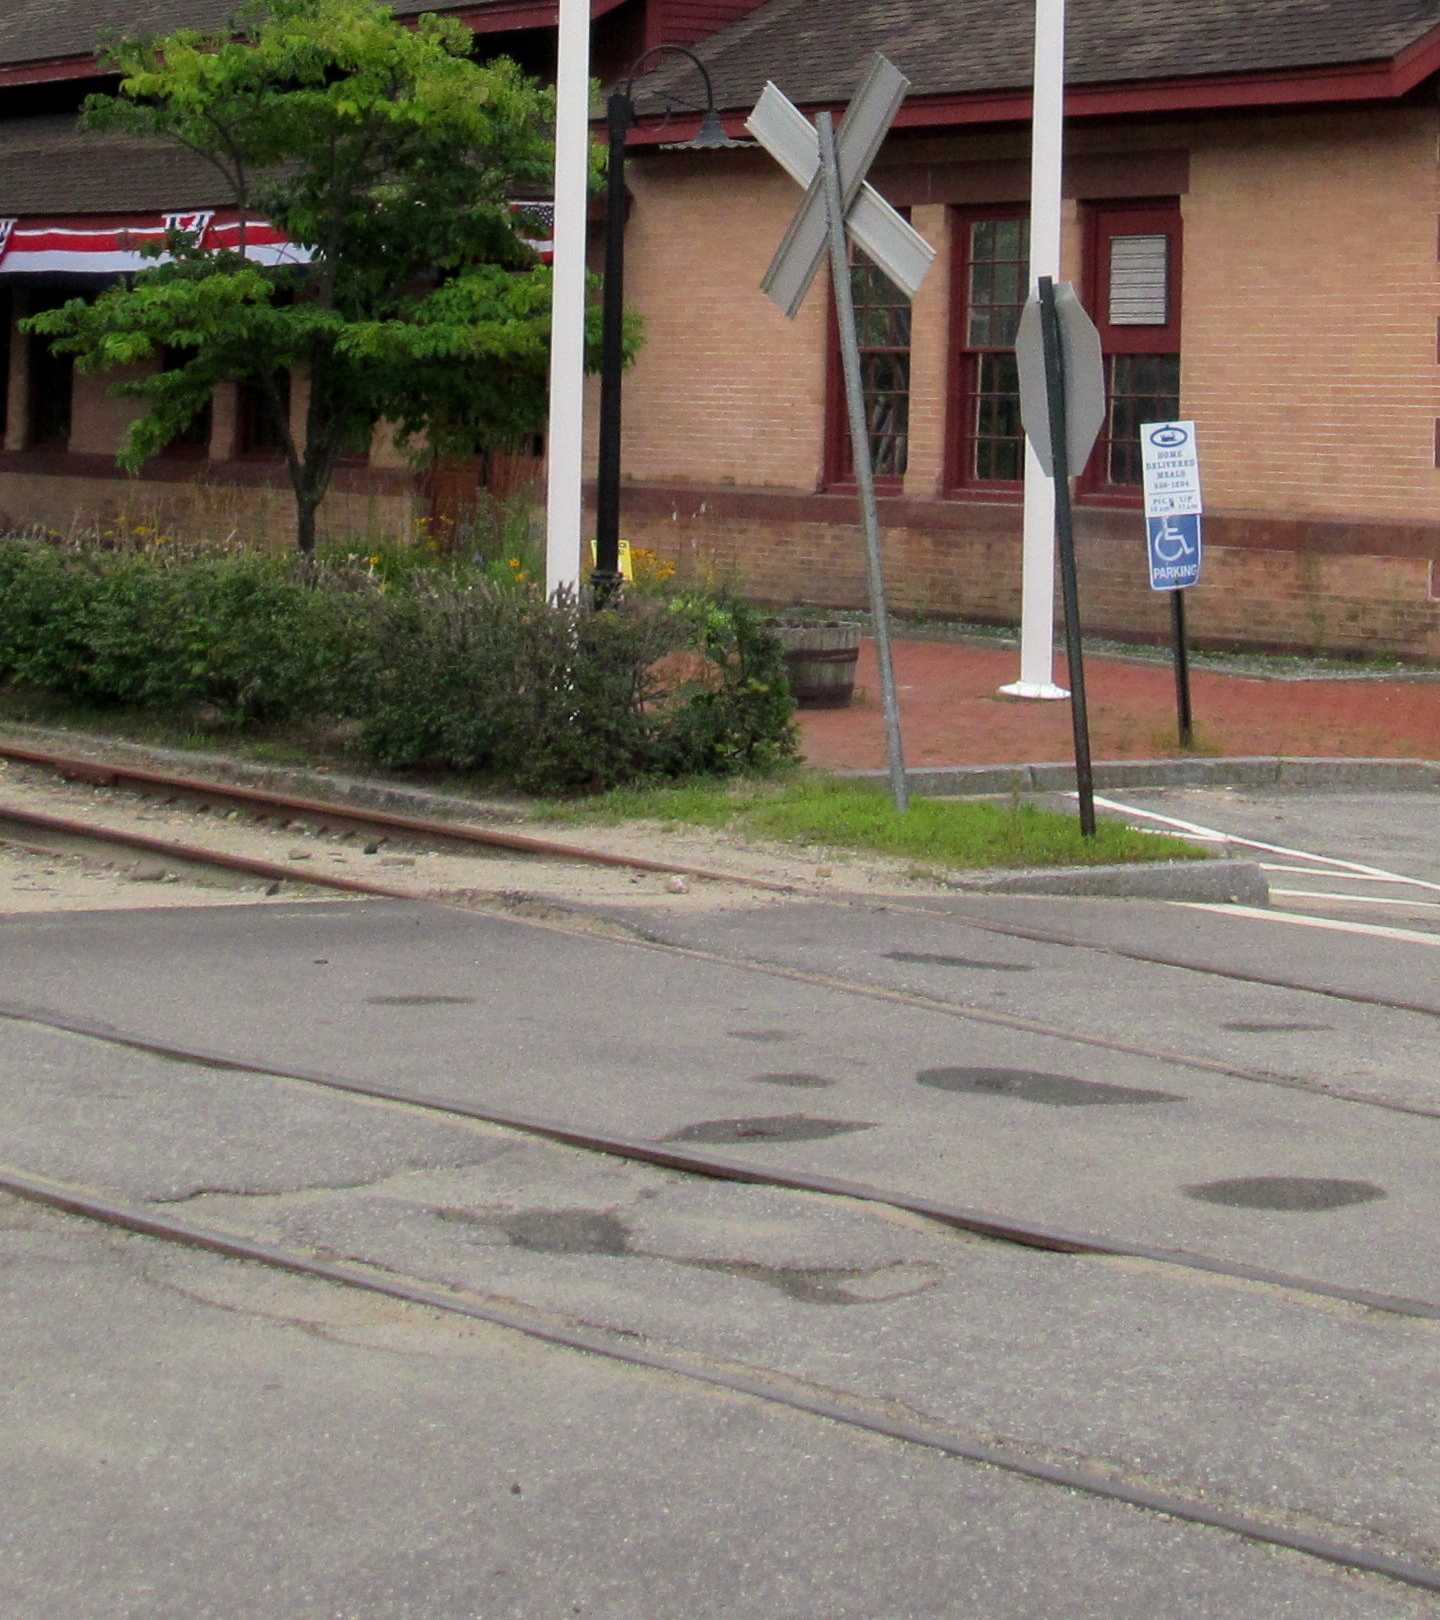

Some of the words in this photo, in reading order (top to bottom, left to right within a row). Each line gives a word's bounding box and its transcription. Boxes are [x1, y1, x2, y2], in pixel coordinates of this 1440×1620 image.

[1157, 450, 1183, 460] HOME
[1145, 459, 1196, 470] DELIVERED
[1156, 469, 1186, 479] MEALS
[1153, 563, 1198, 580] PARKING
